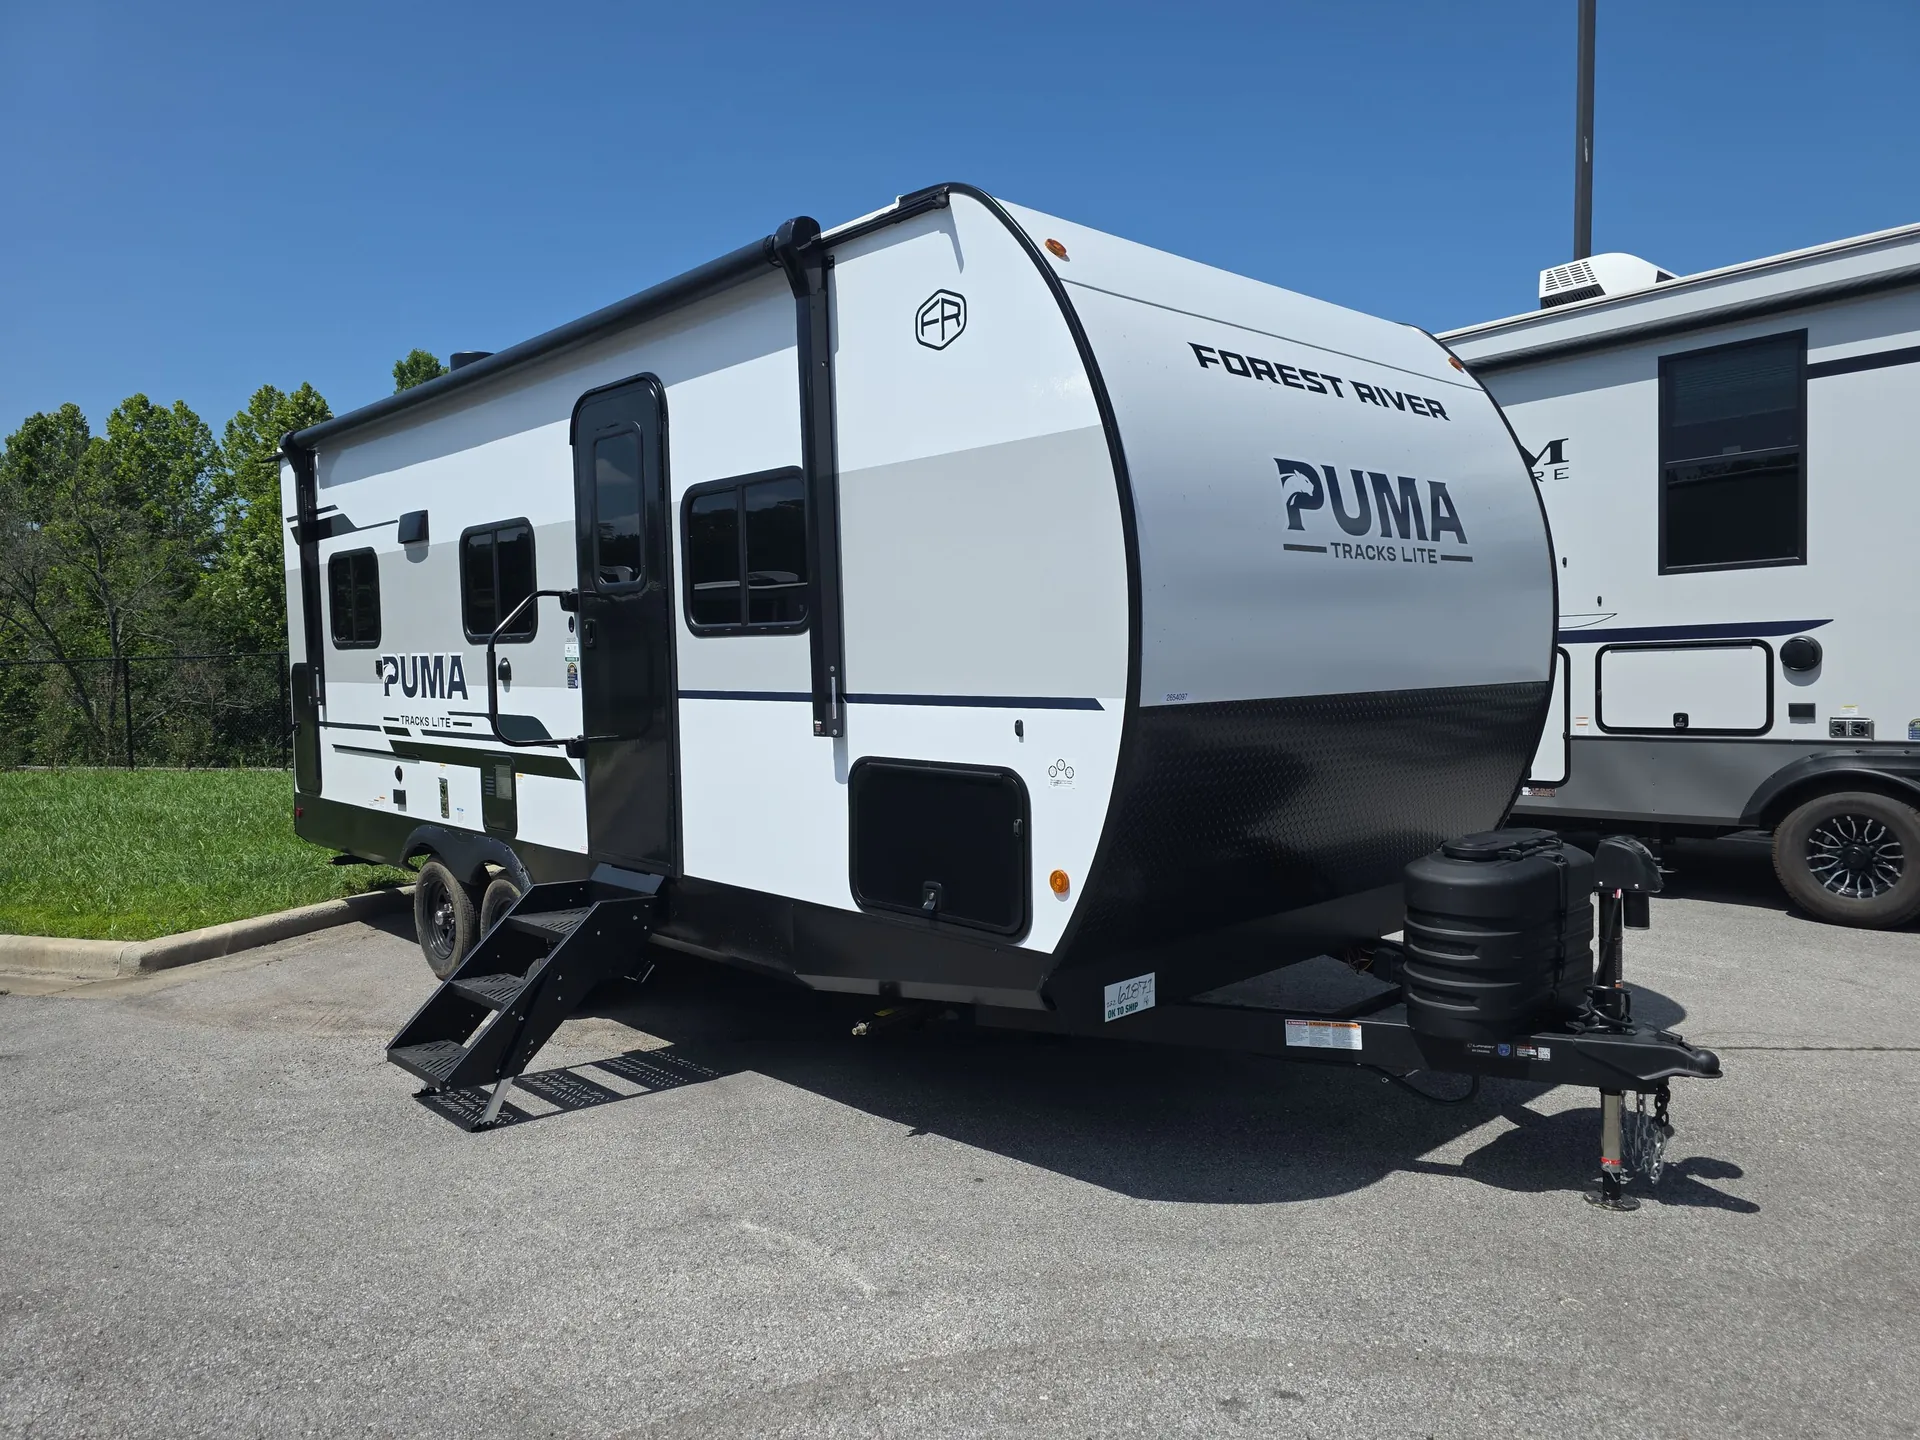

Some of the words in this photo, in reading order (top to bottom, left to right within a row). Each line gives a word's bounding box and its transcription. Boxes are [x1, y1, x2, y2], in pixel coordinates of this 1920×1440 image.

[1187, 341, 1345, 399] FOREST
[1349, 379, 1451, 422] RIVER
[1273, 457, 1469, 545] PUMA
[1330, 541, 1397, 562] TRACKS
[1401, 546, 1438, 565] LITE
[382, 654, 469, 701] PUMA
[400, 715, 430, 727] TRACKS
[431, 717, 451, 728] LITE
[1117, 977, 1154, 1005] 61871
[1107, 1008, 1116, 1019] OK
[1117, 1005, 1125, 1016] TO
[1125, 1001, 1139, 1013] SHIP
